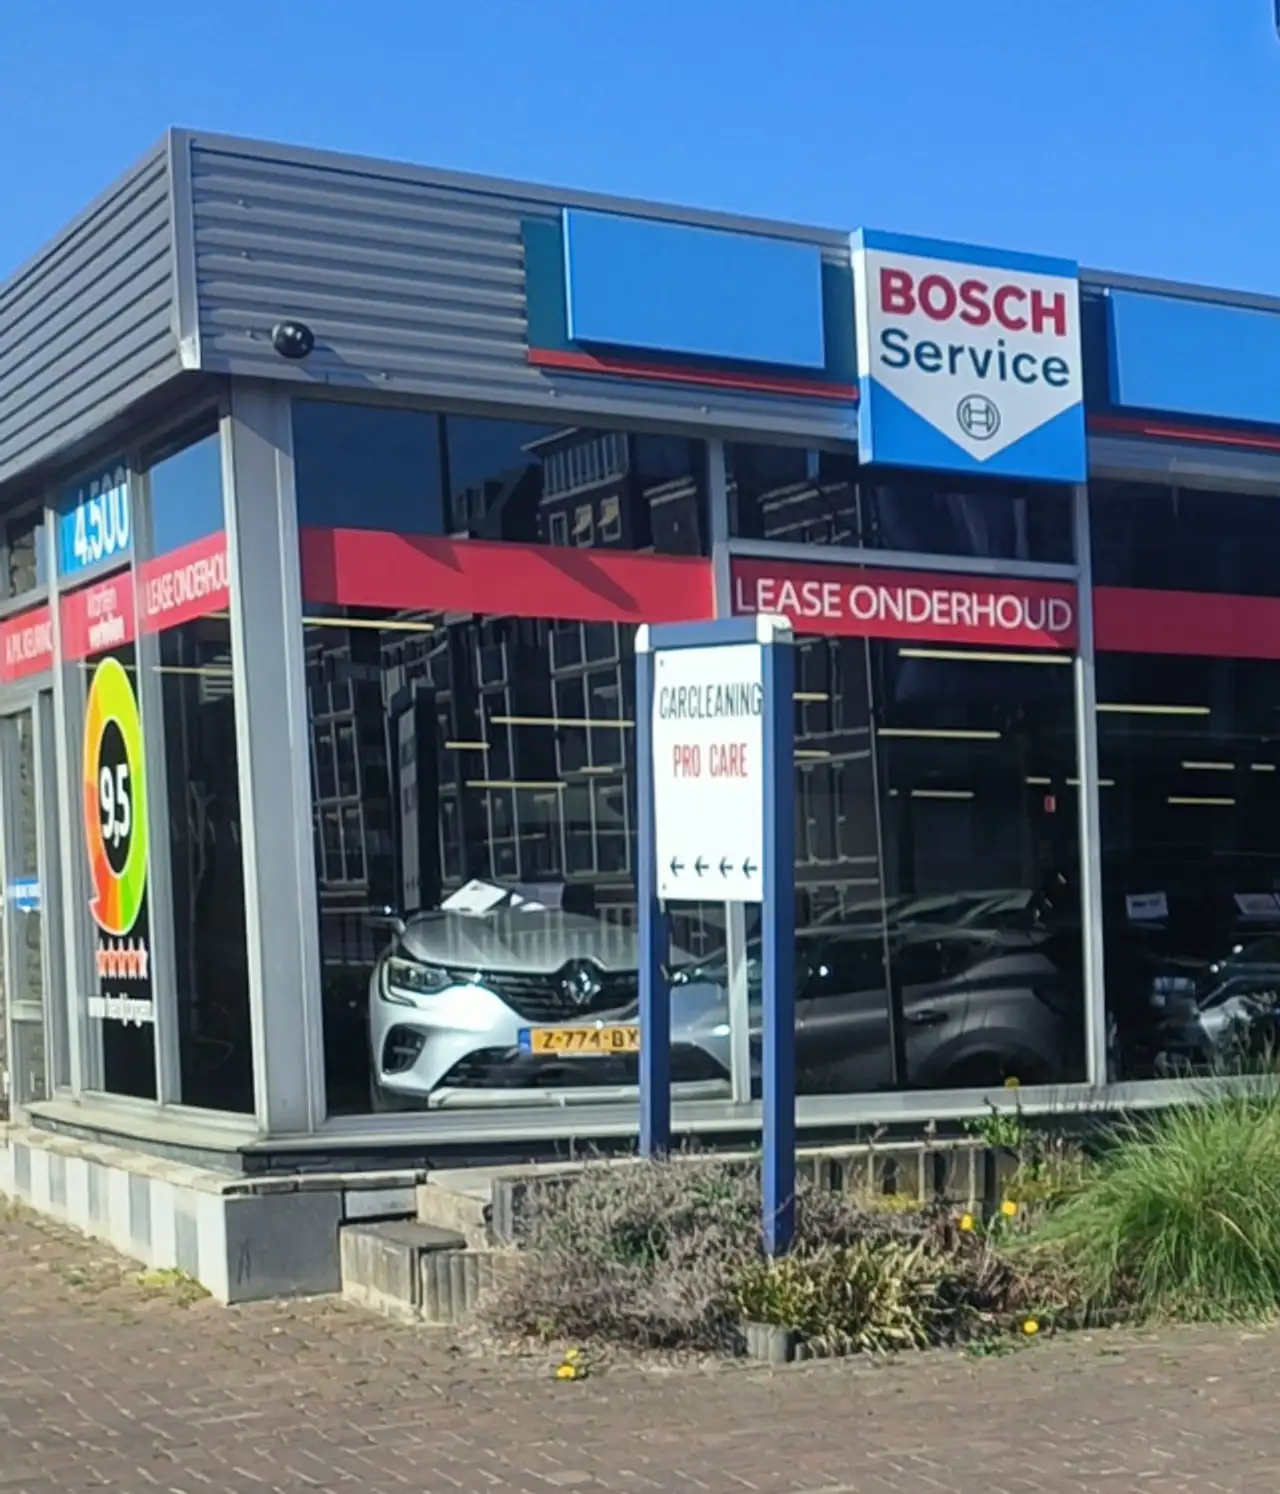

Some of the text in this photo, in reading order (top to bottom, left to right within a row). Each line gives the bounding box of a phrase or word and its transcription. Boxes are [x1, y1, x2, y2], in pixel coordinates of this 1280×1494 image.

[880, 267, 1066, 336] BOSCH
[880, 328, 1069, 387] Service
[74, 466, 130, 565] 4.500
[174, 552, 231, 607] ONDERHOU
[737, 578, 1072, 631] LEASE ONDERHOUD
[659, 682, 764, 719] CARCLEANING
[673, 742, 748, 778] PRO CARE
[101, 763, 130, 849] 9,5
